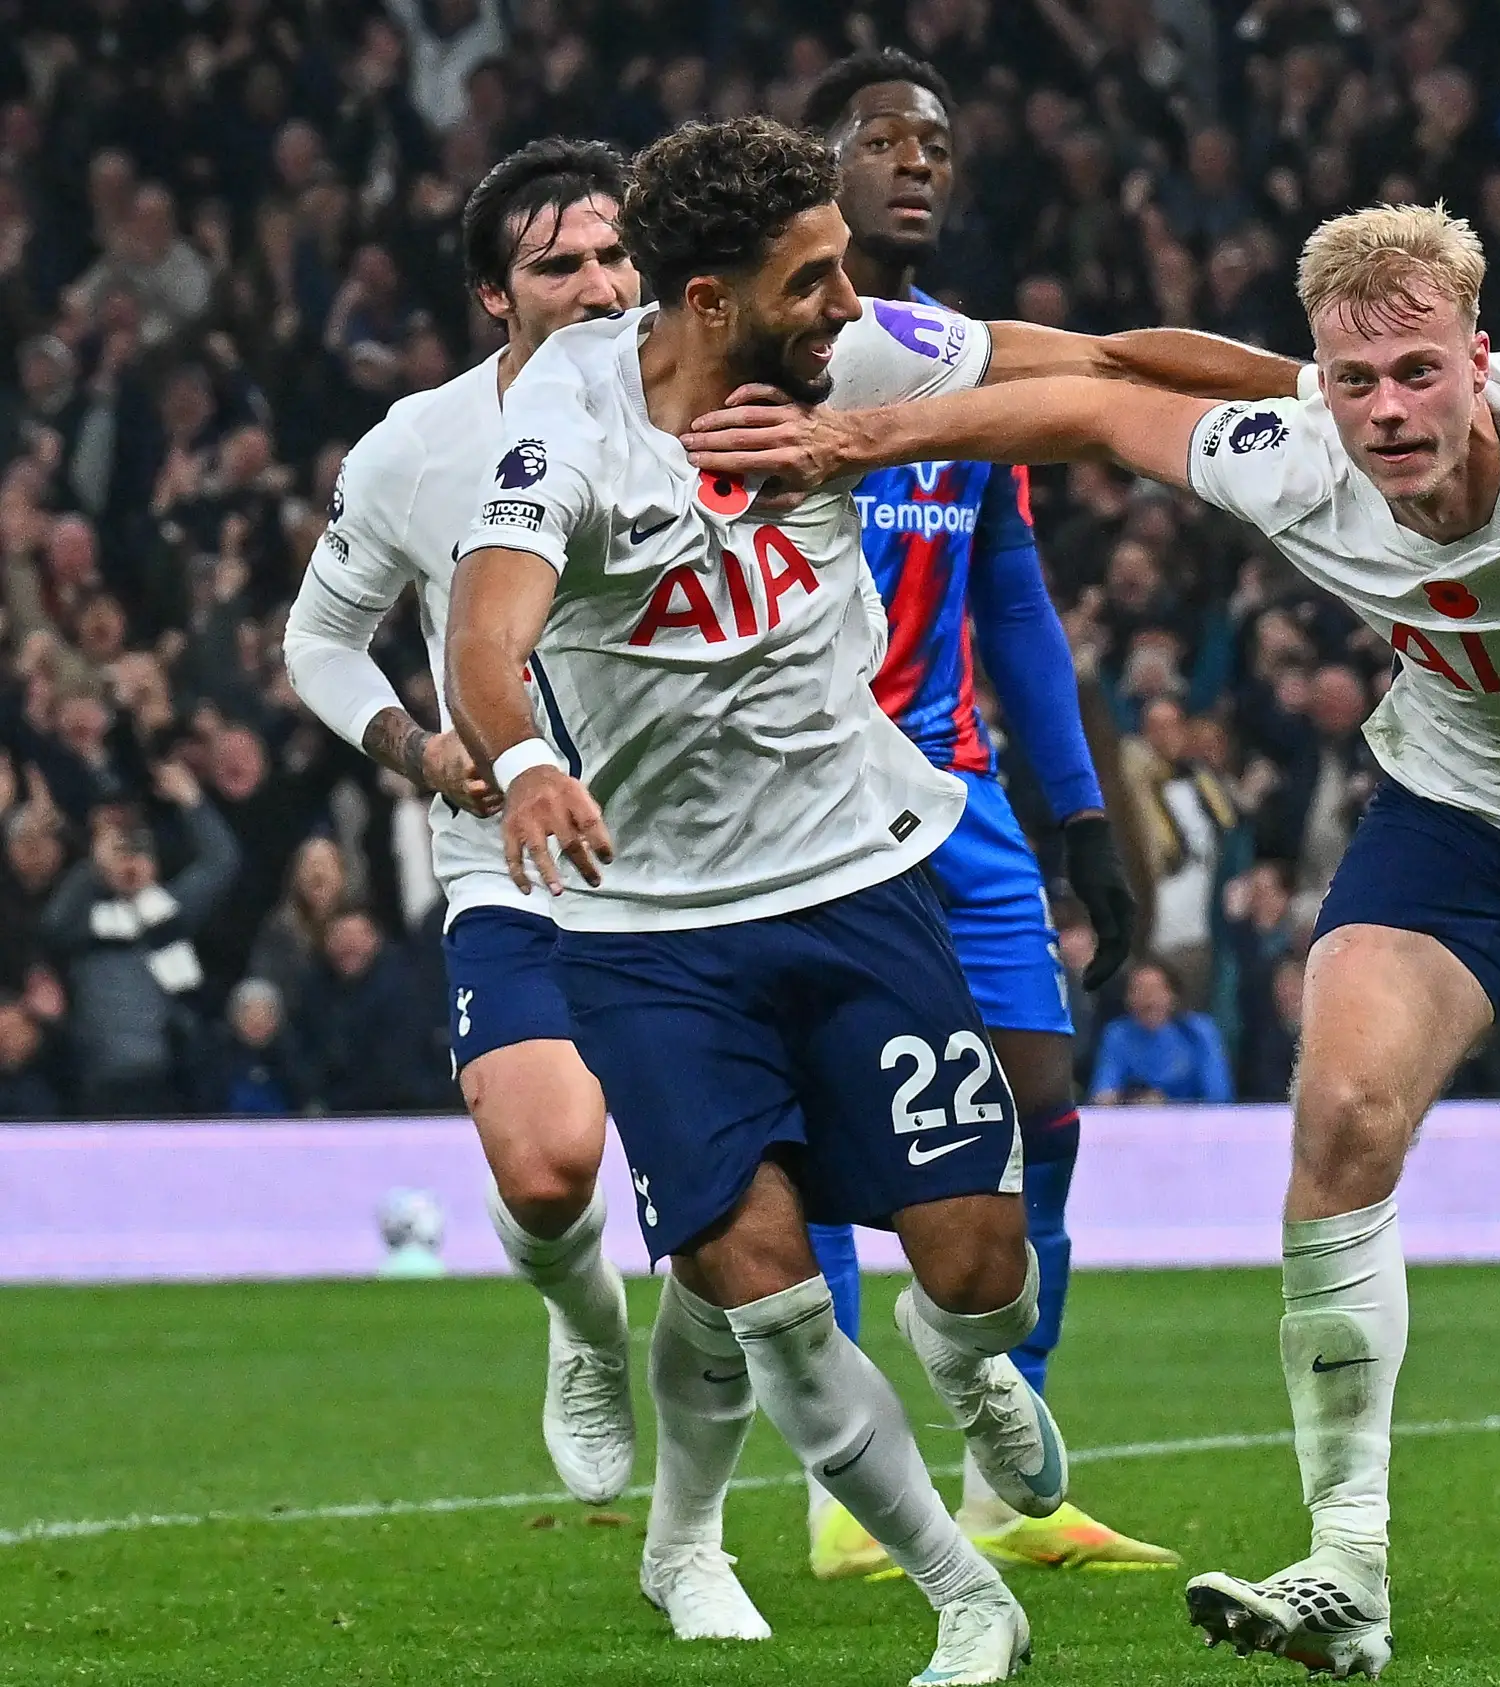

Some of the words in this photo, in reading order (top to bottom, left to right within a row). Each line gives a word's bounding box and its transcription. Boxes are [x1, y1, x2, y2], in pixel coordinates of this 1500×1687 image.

[493, 514, 541, 533] racism
[495, 502, 538, 518] room
[628, 523, 820, 647] AIA
[880, 1030, 1004, 1135] 22
